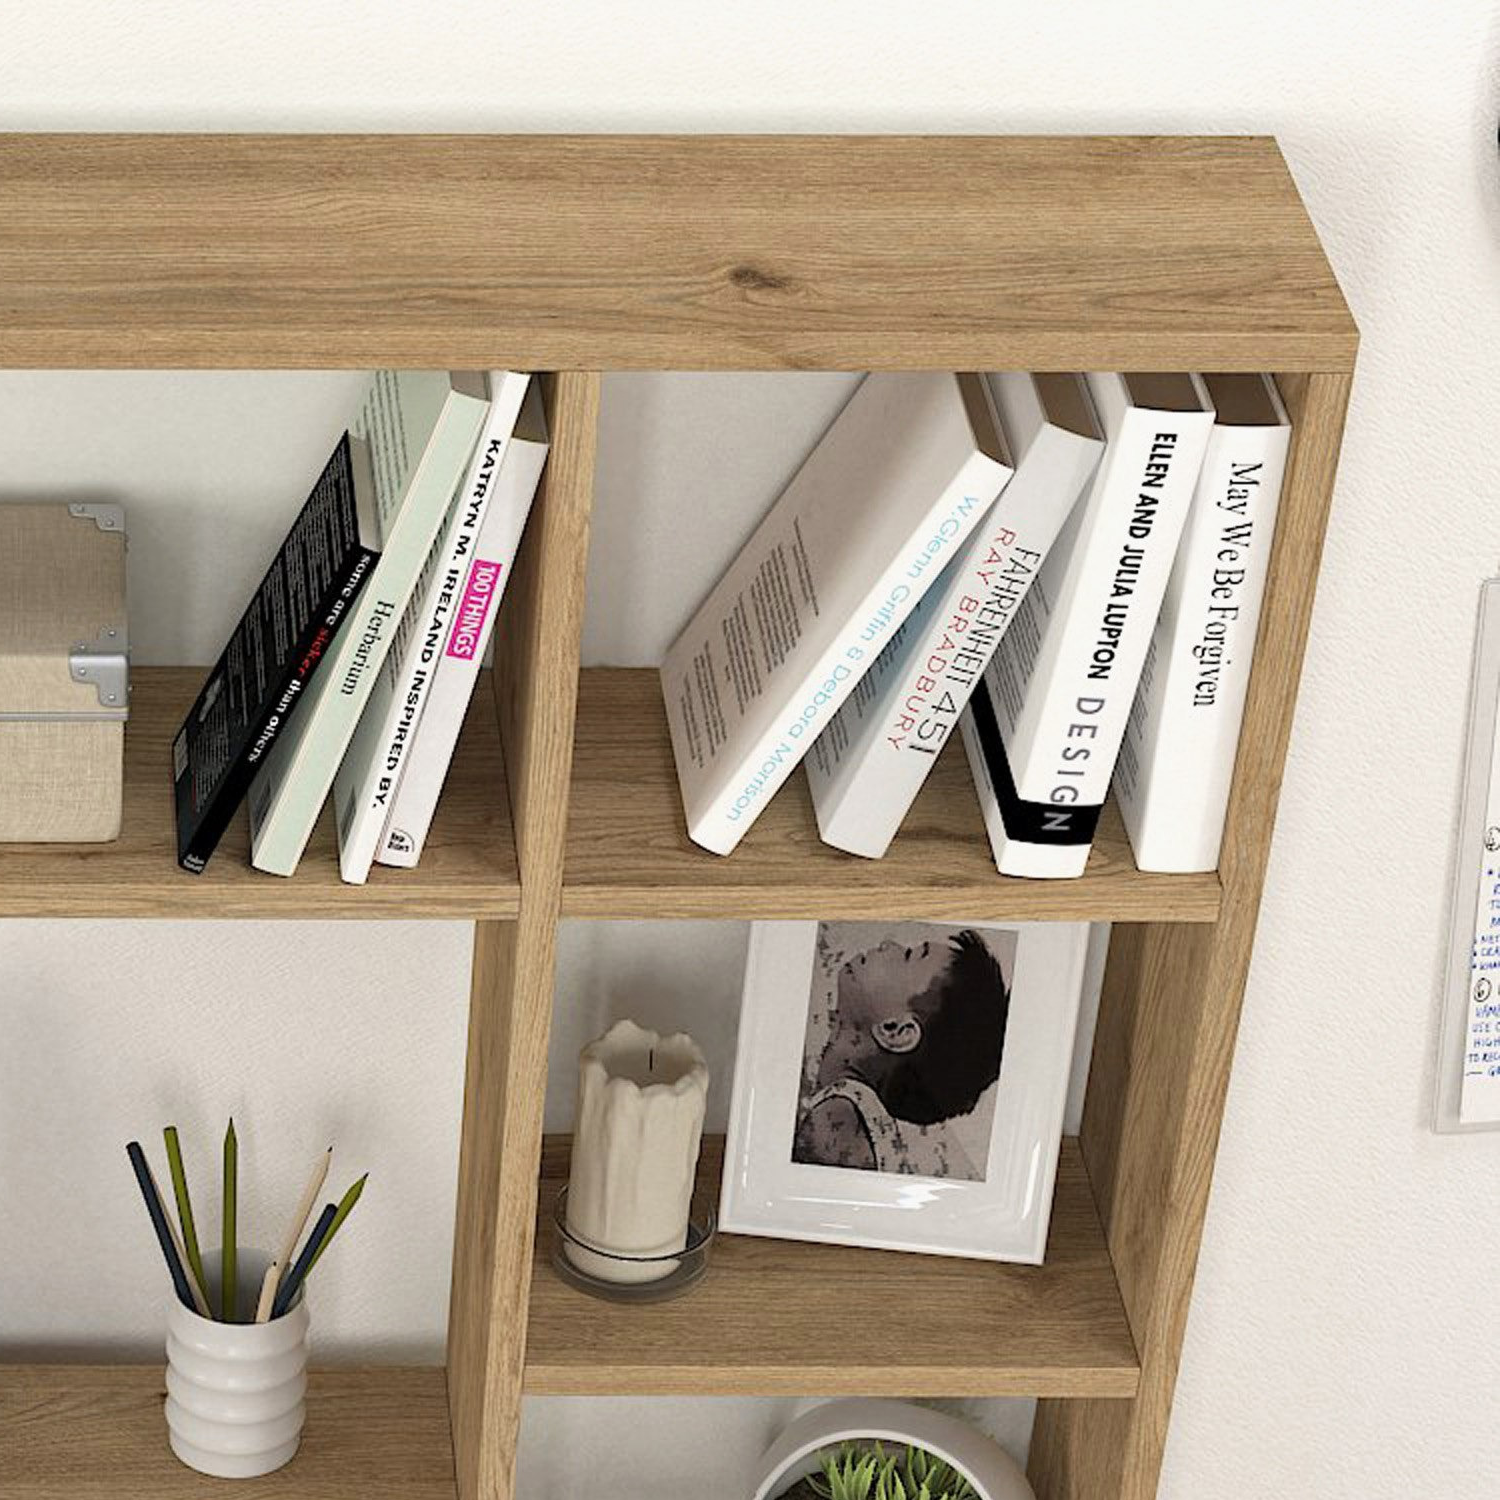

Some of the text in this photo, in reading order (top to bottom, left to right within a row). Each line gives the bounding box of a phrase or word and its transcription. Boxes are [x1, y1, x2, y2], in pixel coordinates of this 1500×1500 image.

[463, 438, 502, 528] KATRYN
[1141, 432, 1178, 488] ELLEN
[453, 534, 471, 561] M.
[1128, 493, 1159, 539] AND
[453, 565, 497, 660] 100 THINGS
[1109, 543, 1145, 598] JULIA
[1192, 462, 1264, 707] May We Be Forgiven
[341, 600, 396, 696] Herbarium
[421, 568, 460, 663] IRELAND
[860, 584, 911, 642] Griffin
[887, 527, 1017, 751] RAY BRADBURY
[945, 546, 1042, 689] FAHRENHEIT
[1087, 603, 1129, 680] LUPTON
[248, 553, 372, 763] some are sicker than others
[386, 670, 427, 772] INSPIRED
[788, 664, 853, 739] Debora
[908, 691, 958, 755] 451
[372, 777, 392, 809] BY.
[726, 742, 792, 821] Morrison
[1041, 697, 1106, 831] DESIGN
